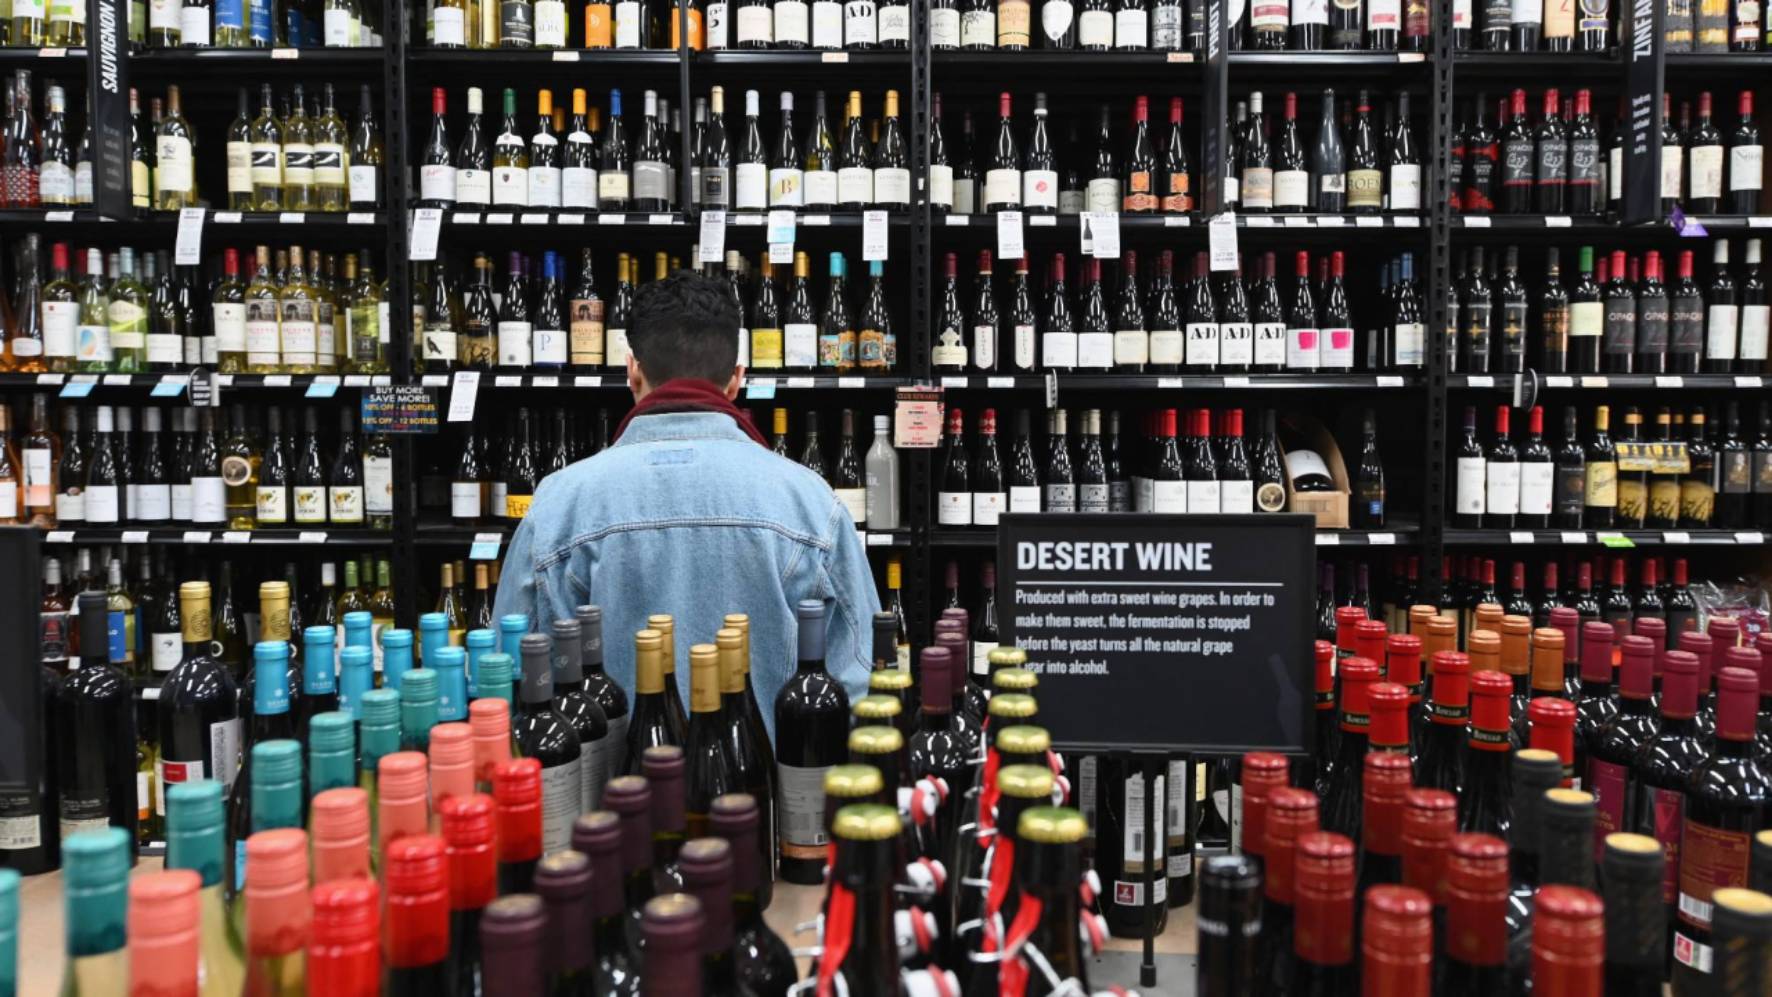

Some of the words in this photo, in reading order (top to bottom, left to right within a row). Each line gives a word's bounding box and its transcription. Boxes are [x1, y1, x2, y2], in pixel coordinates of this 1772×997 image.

[99, 1, 118, 93] SAUVIGNON
[541, 334, 551, 350] P
[369, 394, 395, 402] SAVE
[1017, 541, 1130, 571] DESERT
[1134, 541, 1213, 571] WINE
[1015, 589, 1065, 605] Produced
[1066, 589, 1090, 605] with
[1091, 592, 1118, 605] extra
[1119, 591, 1150, 606] sweet
[1152, 591, 1178, 606] wine
[1178, 592, 1219, 609] grapes.
[1219, 590, 1232, 606] In
[1232, 591, 1261, 606] order
[1262, 593, 1276, 606] to
[1015, 612, 1044, 627] make
[1045, 612, 1071, 628] them
[1108, 613, 1126, 628] the
[1127, 613, 1195, 630] fermentation
[1196, 614, 1207, 630] is
[1207, 614, 1251, 633] stopped
[1015, 636, 1049, 651] before
[1050, 636, 1068, 651] the
[1069, 638, 1098, 655] yeast
[1099, 638, 1128, 652] turns
[1129, 637, 1142, 652] all
[1143, 637, 1162, 653] the
[1162, 637, 1201, 653] natural
[1202, 640, 1234, 657] grape
[1045, 660, 1068, 675] into
[1068, 659, 1110, 675] alcohol.
